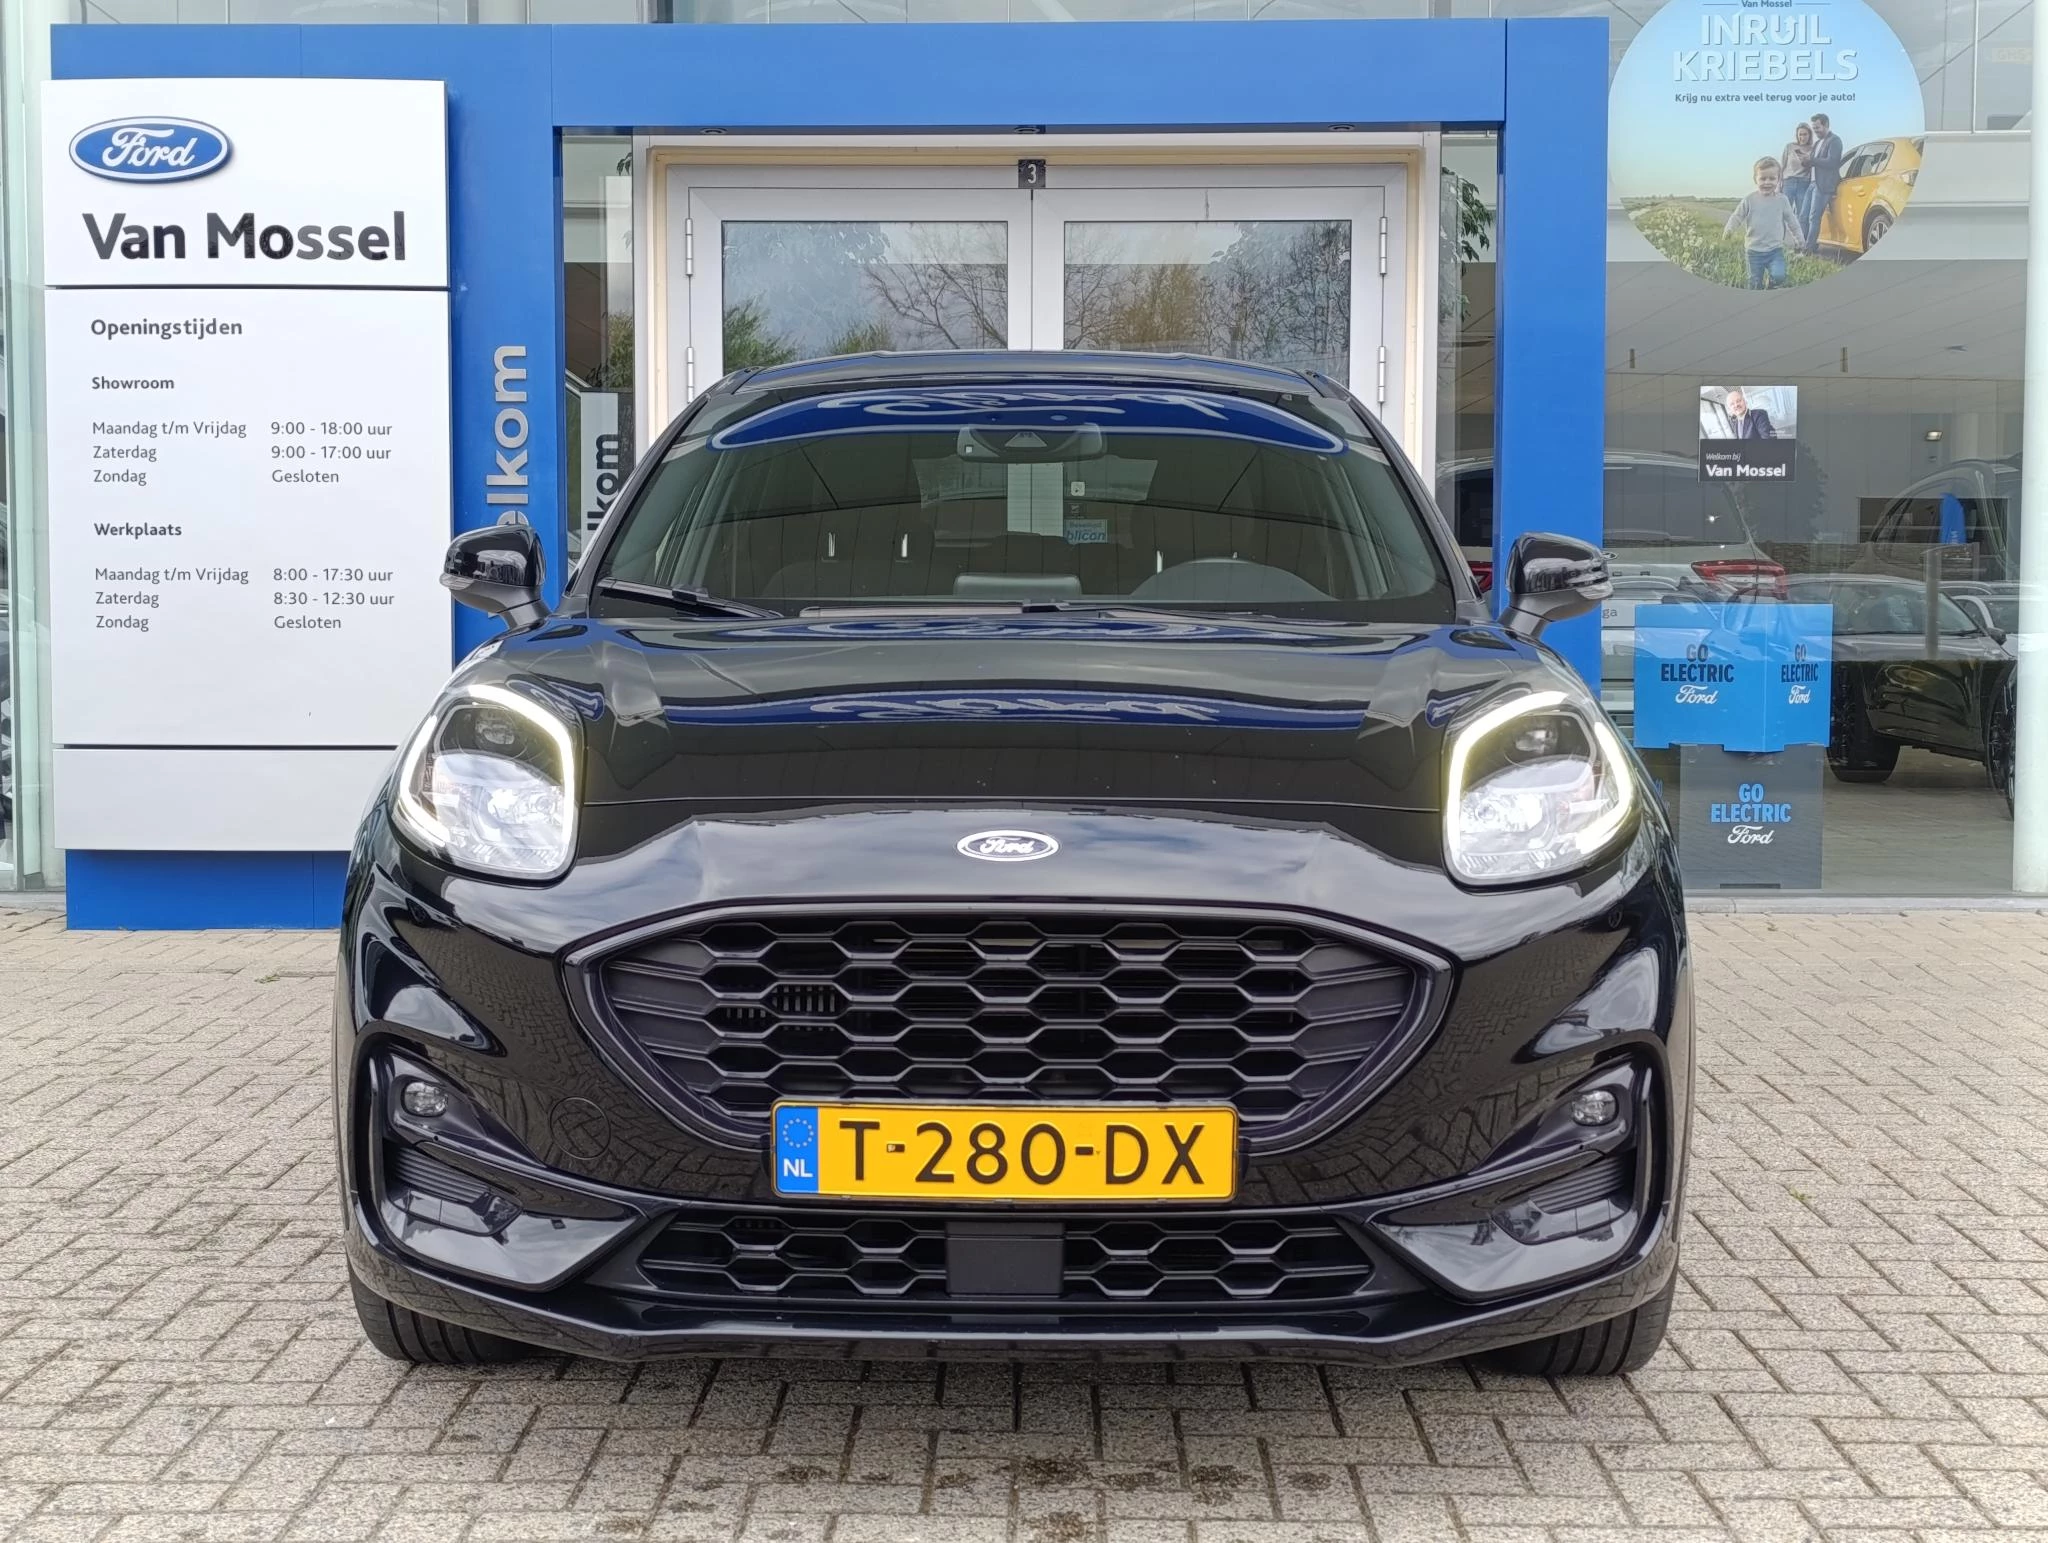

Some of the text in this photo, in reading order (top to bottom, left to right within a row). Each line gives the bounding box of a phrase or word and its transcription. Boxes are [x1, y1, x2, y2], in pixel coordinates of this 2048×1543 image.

[1741, 0, 1793, 8] Van Mossel
[1701, 13, 1832, 46] INRUIL
[1673, 50, 1860, 81] KRIEBELS
[1675, 92, 1856, 104] Krijg nu extra veel terug voor je auto!
[102, 128, 198, 167] Ford
[1027, 163, 1037, 184] 3
[82, 211, 406, 262] Van Mossel
[91, 317, 243, 341] Openingstijden
[91, 375, 175, 391] Showroom
[92, 420, 158, 439] Maandag
[161, 420, 189, 435] t/m
[193, 420, 247, 439] Vrijdag
[270, 421, 306, 435] 9:00
[320, 421, 363, 436] 18:00
[367, 425, 393, 436] uur
[486, 345, 529, 527] lkom
[93, 444, 158, 463] Zaterdag
[271, 445, 306, 459] 9:00
[320, 445, 362, 459] 17:00
[366, 449, 392, 460] uur
[93, 468, 340, 487] Zondag Gesloten
[1705, 463, 1786, 477] Van Mossel
[587, 434, 620, 530] kom
[93, 521, 183, 541] Werkplaats
[95, 566, 162, 585] Maandag
[163, 566, 190, 581] t/m
[195, 567, 249, 585] Vrijdag
[273, 567, 308, 581] 8:00
[322, 568, 364, 582] 17:30
[368, 571, 394, 582] uur
[95, 590, 160, 609] Zaterdag
[273, 591, 308, 605] 8:30
[322, 591, 365, 605] 12:30
[369, 595, 395, 606] uur
[1602, 608, 1618, 619] ga
[95, 614, 342, 633] Zondag Gesloten
[1686, 644, 1709, 662] GO
[1794, 644, 1807, 662] GO
[1661, 663, 1735, 683] ELECTRIC
[1781, 663, 1819, 683] ELECTRIC
[1675, 685, 1719, 704] Ford
[1788, 685, 1811, 704] Ford
[1738, 783, 1765, 803] GO
[1711, 803, 1792, 823] ELECTRIC
[1727, 824, 1775, 844] Ford
[979, 836, 1036, 854] Ford
[839, 1119, 1205, 1185] T-280-DX
[782, 1158, 814, 1179] NL
